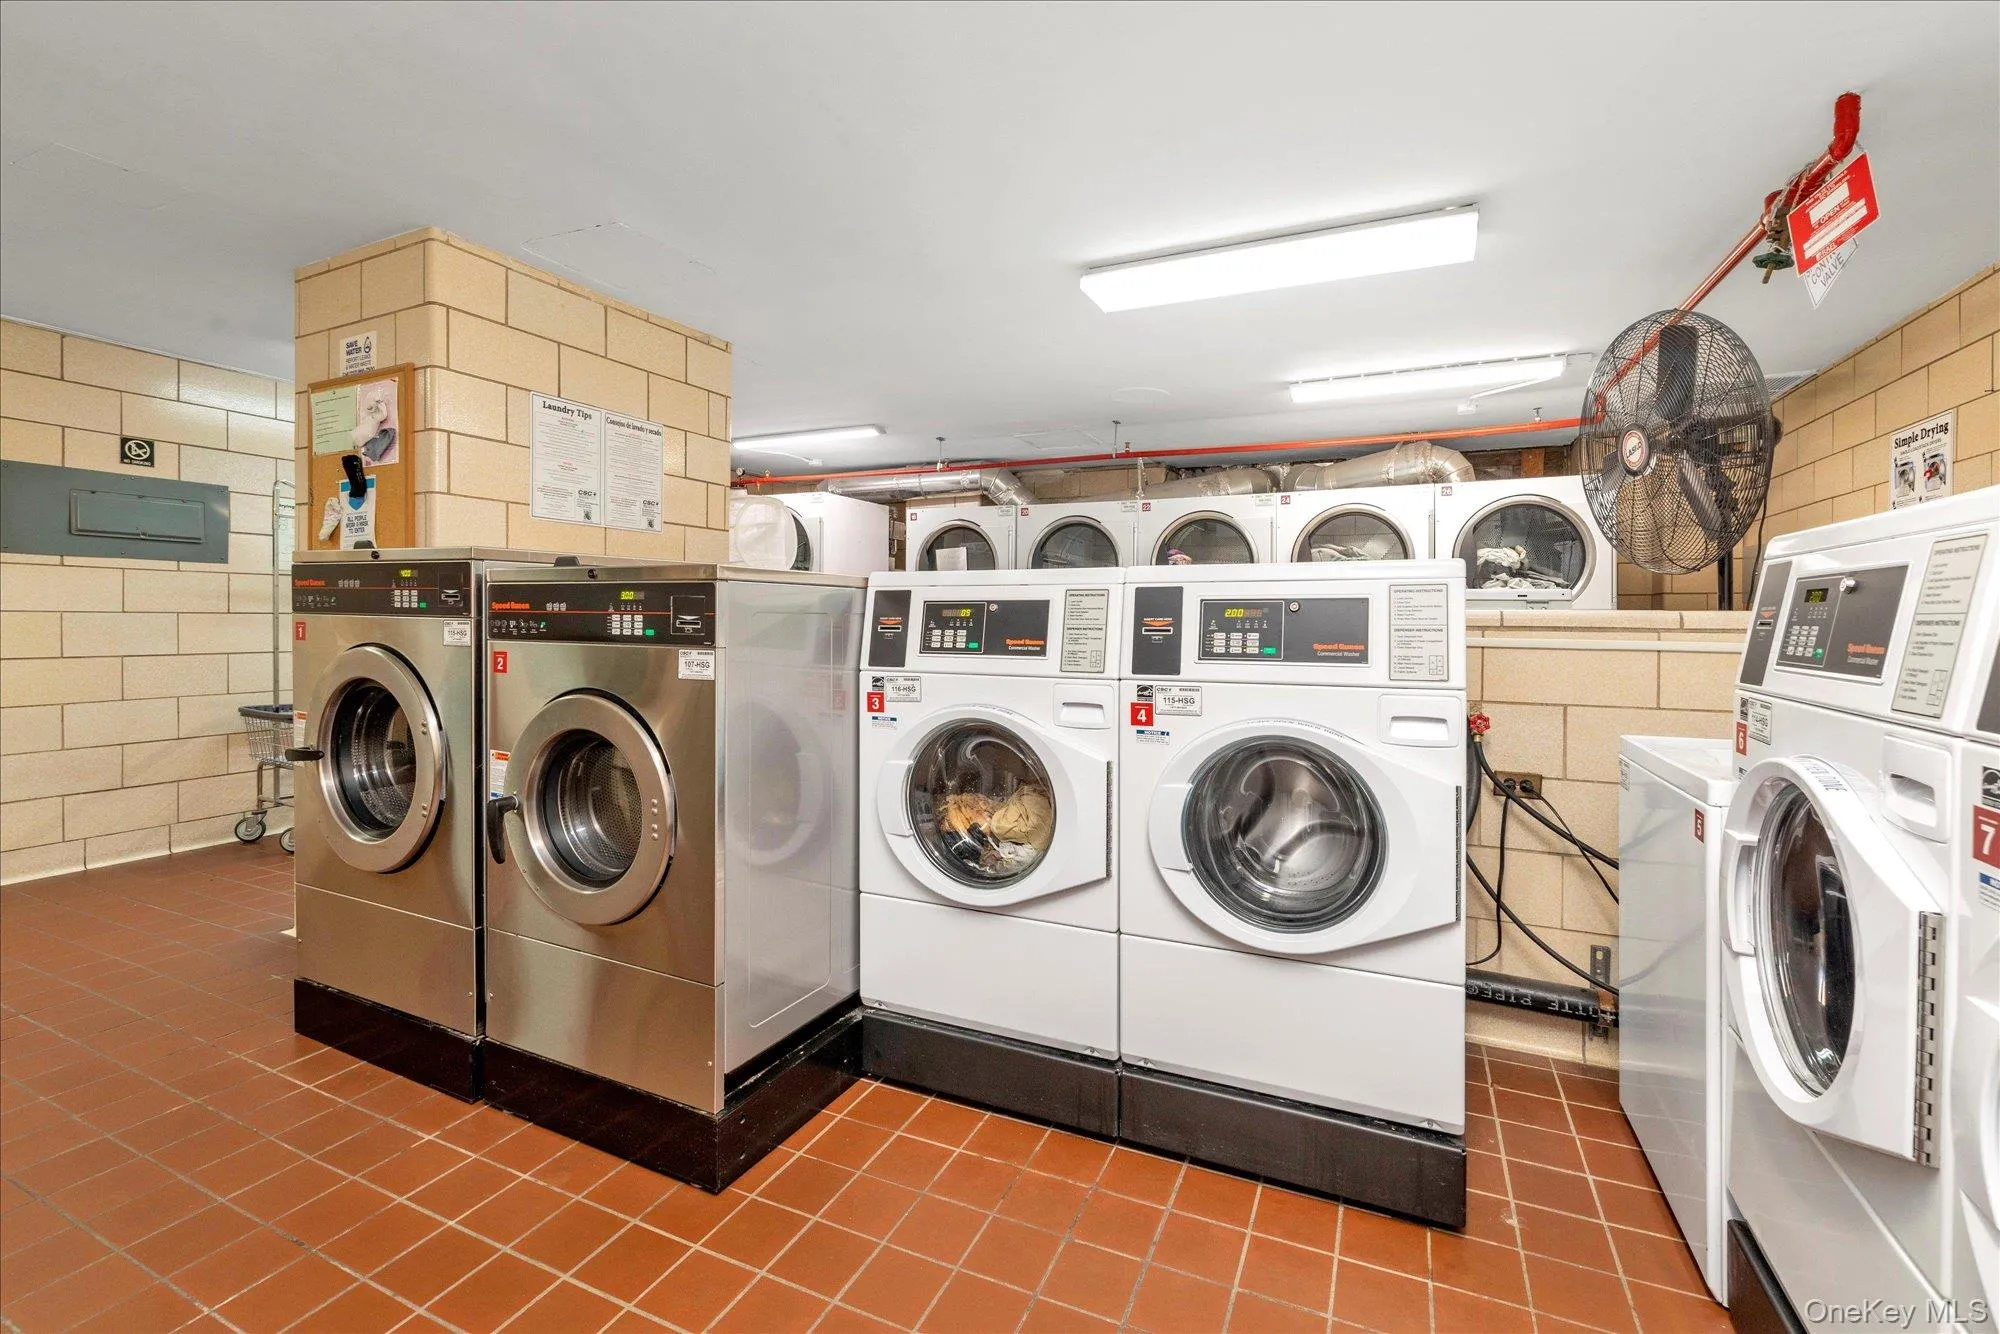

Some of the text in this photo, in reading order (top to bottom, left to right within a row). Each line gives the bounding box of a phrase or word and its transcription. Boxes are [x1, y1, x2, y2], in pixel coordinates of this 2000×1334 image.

[1819, 204, 1840, 224] OPEN
[1820, 252, 1844, 286] VALVE
[346, 340, 358, 349] SAVE
[346, 346, 362, 356] WATER
[542, 401, 592, 420] Laundry Tips
[606, 416, 625, 428] Consejos
[626, 421, 631, 429] de
[1894, 432, 1918, 449] Simple
[1920, 422, 1949, 440] Drying
[491, 601, 530, 610] Speed Queen
[298, 627, 302, 638] 1
[1847, 643, 1866, 654] Speed
[497, 657, 503, 669] 2
[872, 698, 879, 710] 3
[1137, 709, 1147, 722] 4
[1739, 732, 1744, 749] 6
[1697, 819, 1702, 836] 5
[1980, 824, 1996, 855] 7
